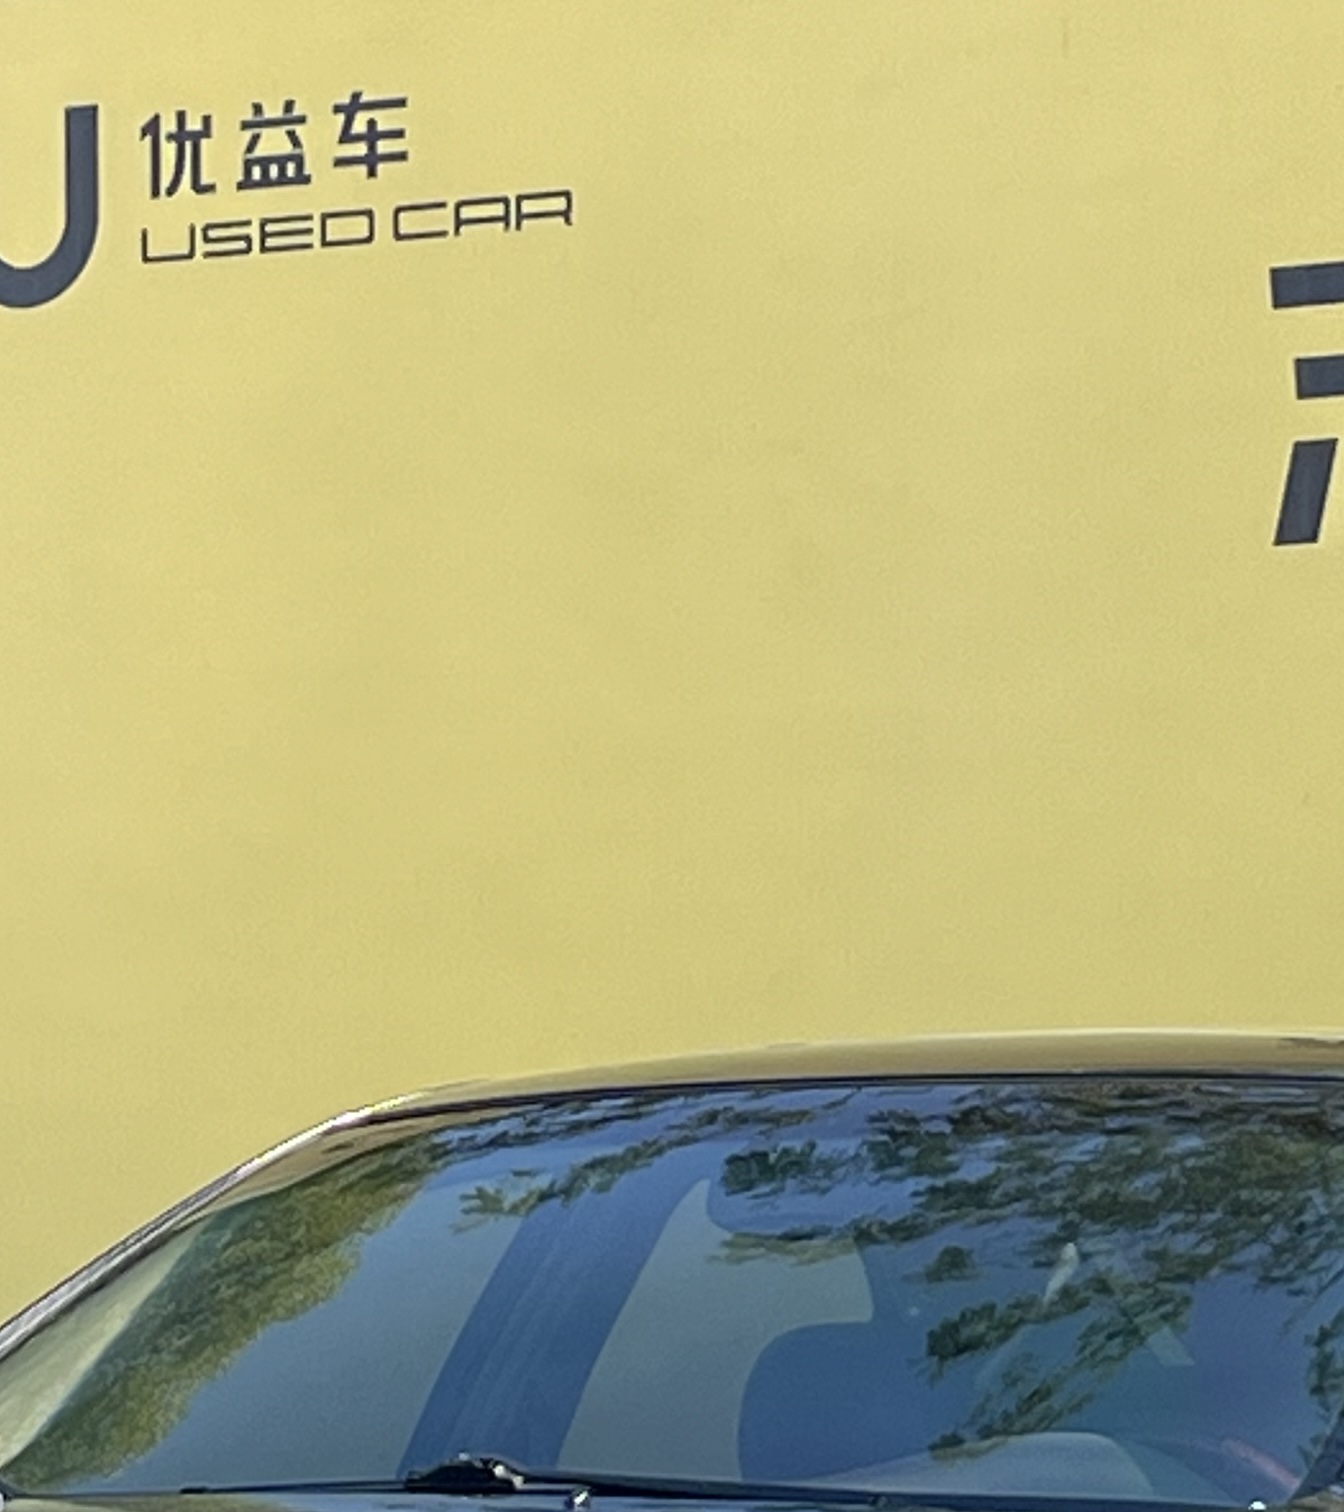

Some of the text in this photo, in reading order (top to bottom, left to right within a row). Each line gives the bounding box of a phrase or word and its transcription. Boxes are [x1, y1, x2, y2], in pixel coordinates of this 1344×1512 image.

[140, 91, 408, 199] 优益车
[141, 190, 572, 264] USED CAR
